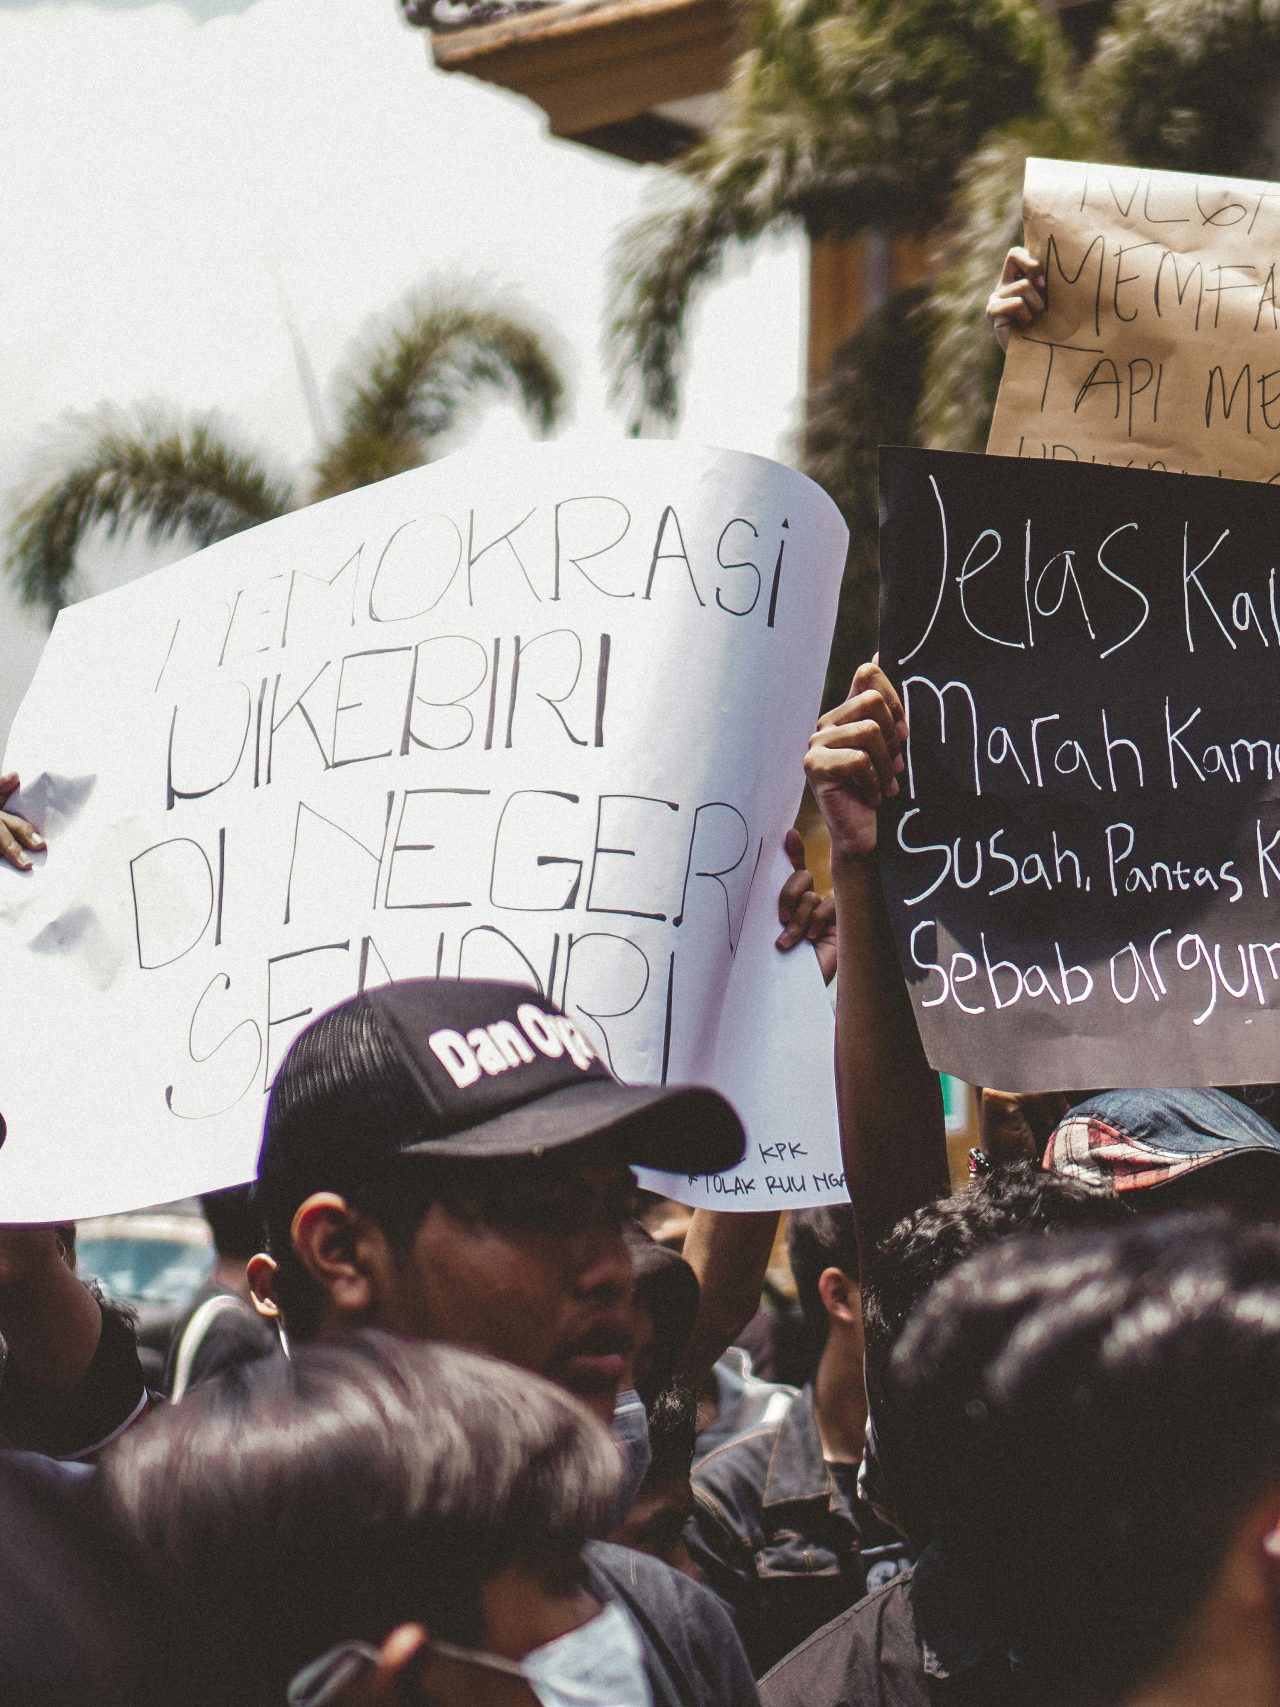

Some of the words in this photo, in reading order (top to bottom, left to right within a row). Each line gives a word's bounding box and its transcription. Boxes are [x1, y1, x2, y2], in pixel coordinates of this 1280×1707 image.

[1022, 335, 1164, 438] TAPI
[899, 474, 1149, 665] Jelas
[899, 675, 1143, 799] Marah
[129, 826, 227, 970] DI
[1105, 822, 1243, 903] Pantas
[909, 919, 1095, 1015] Sebab
[758, 1142, 808, 1164] KPK
